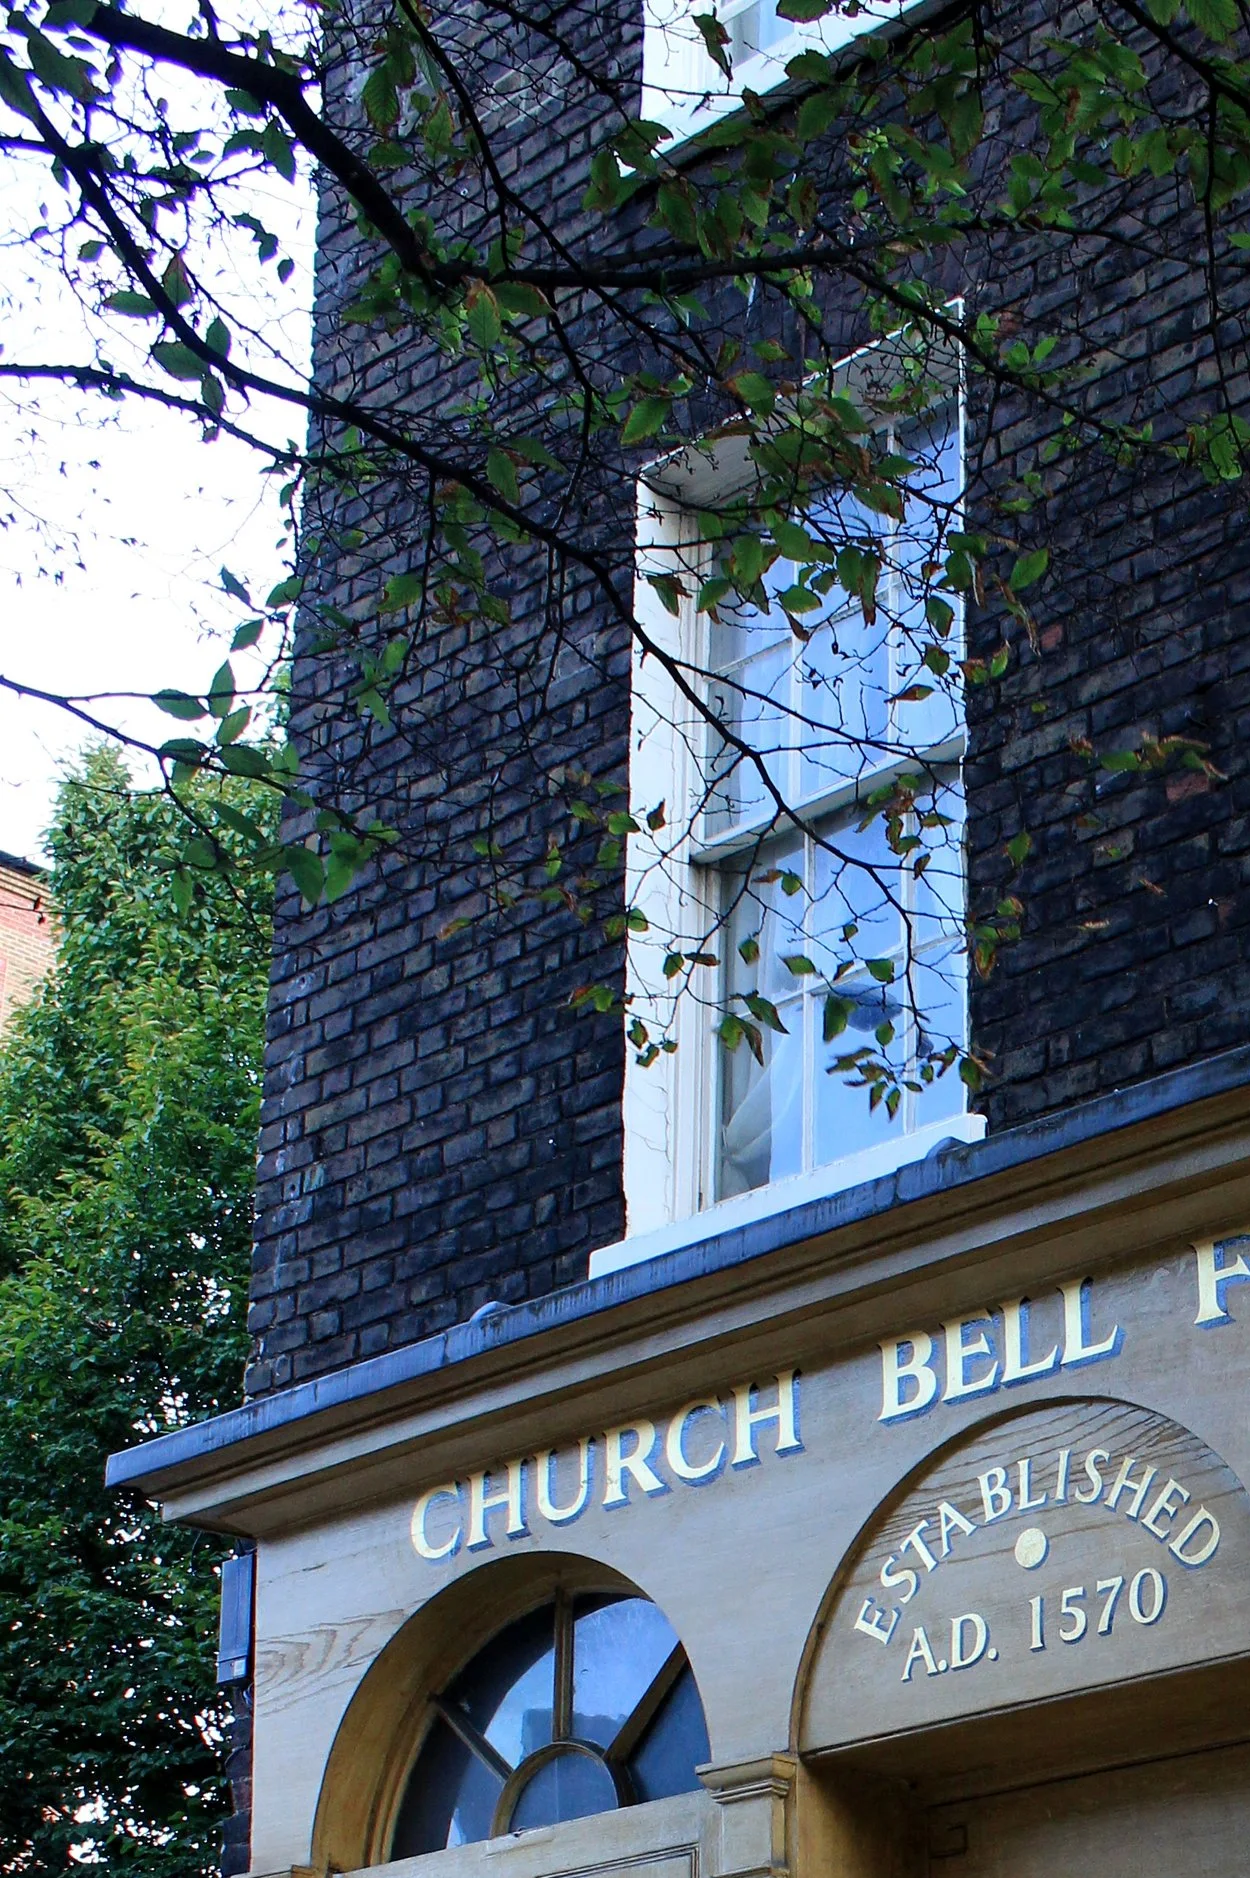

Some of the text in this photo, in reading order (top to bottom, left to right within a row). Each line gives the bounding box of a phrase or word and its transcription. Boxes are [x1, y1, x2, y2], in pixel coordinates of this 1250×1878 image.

[410, 1369, 804, 1562] CHURCH
[877, 1276, 1124, 1426] BELL
[853, 1448, 1222, 1645] ESTABLISHED
[900, 1567, 1168, 1683] A.D. 1570
